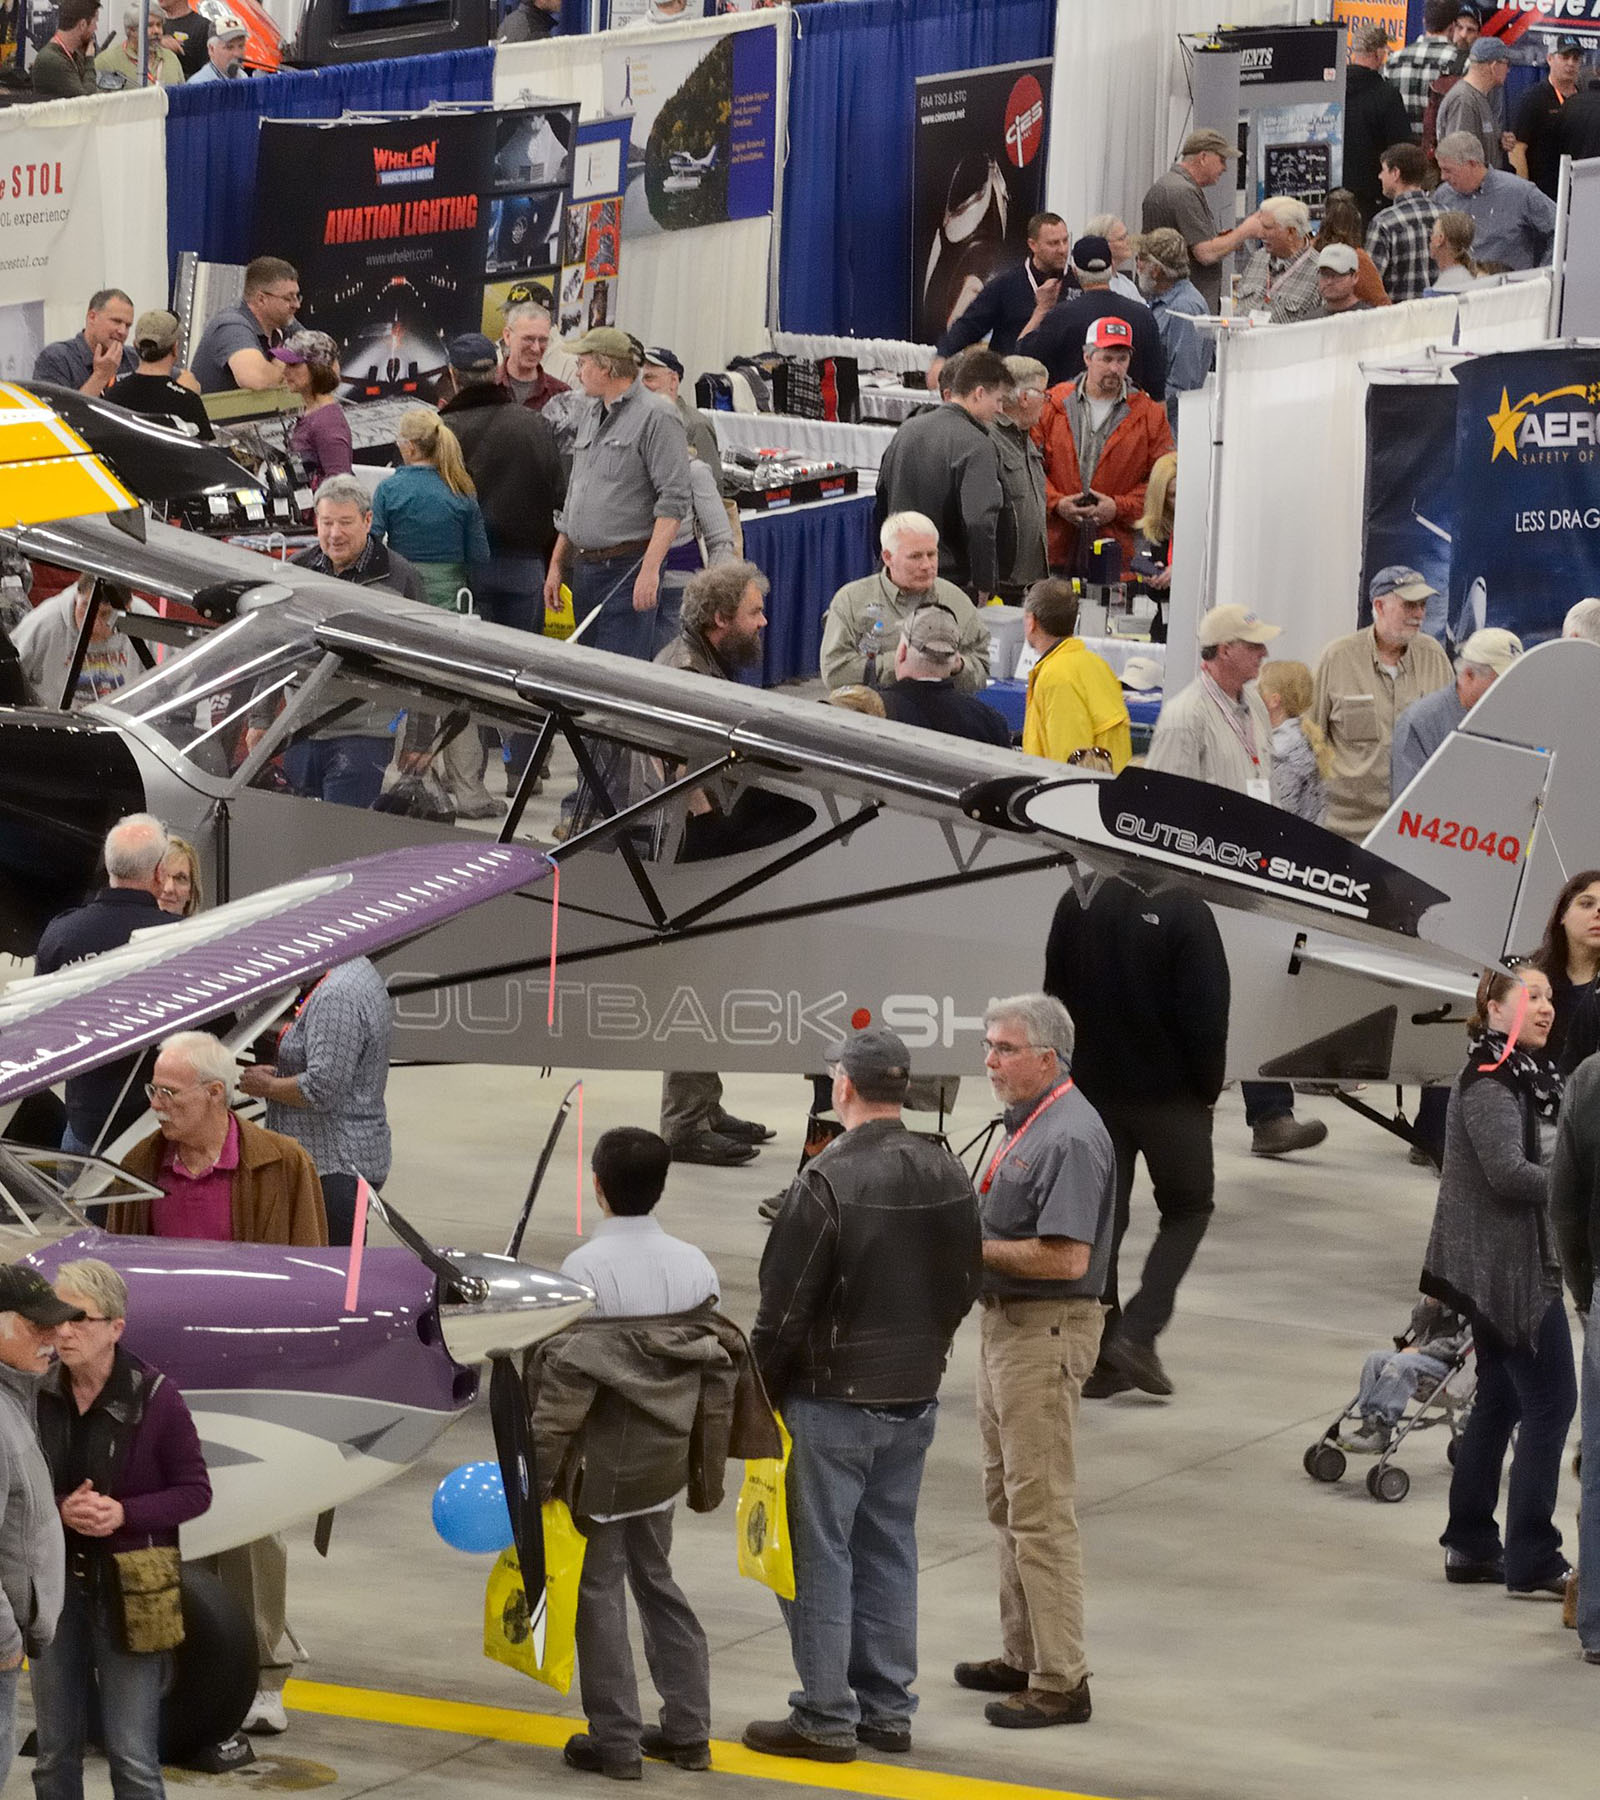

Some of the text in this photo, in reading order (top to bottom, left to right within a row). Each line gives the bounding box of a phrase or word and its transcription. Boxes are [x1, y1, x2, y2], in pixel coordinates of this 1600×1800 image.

[1240, 47, 1274, 67] ENTS
[373, 140, 437, 171] WHELEN
[12, 162, 63, 198] STOL
[324, 193, 479, 245] AVIATION LIGHTING
[366, 248, 434, 266] www.whelen.com
[1521, 450, 1595, 466] SAFETY OF
[1515, 508, 1600, 533] LESS DRAG
[1397, 810, 1521, 865] N4204Q
[1116, 812, 1371, 902] OUTBACK SHOCK
[388, 971, 848, 1046] OUTBACK
